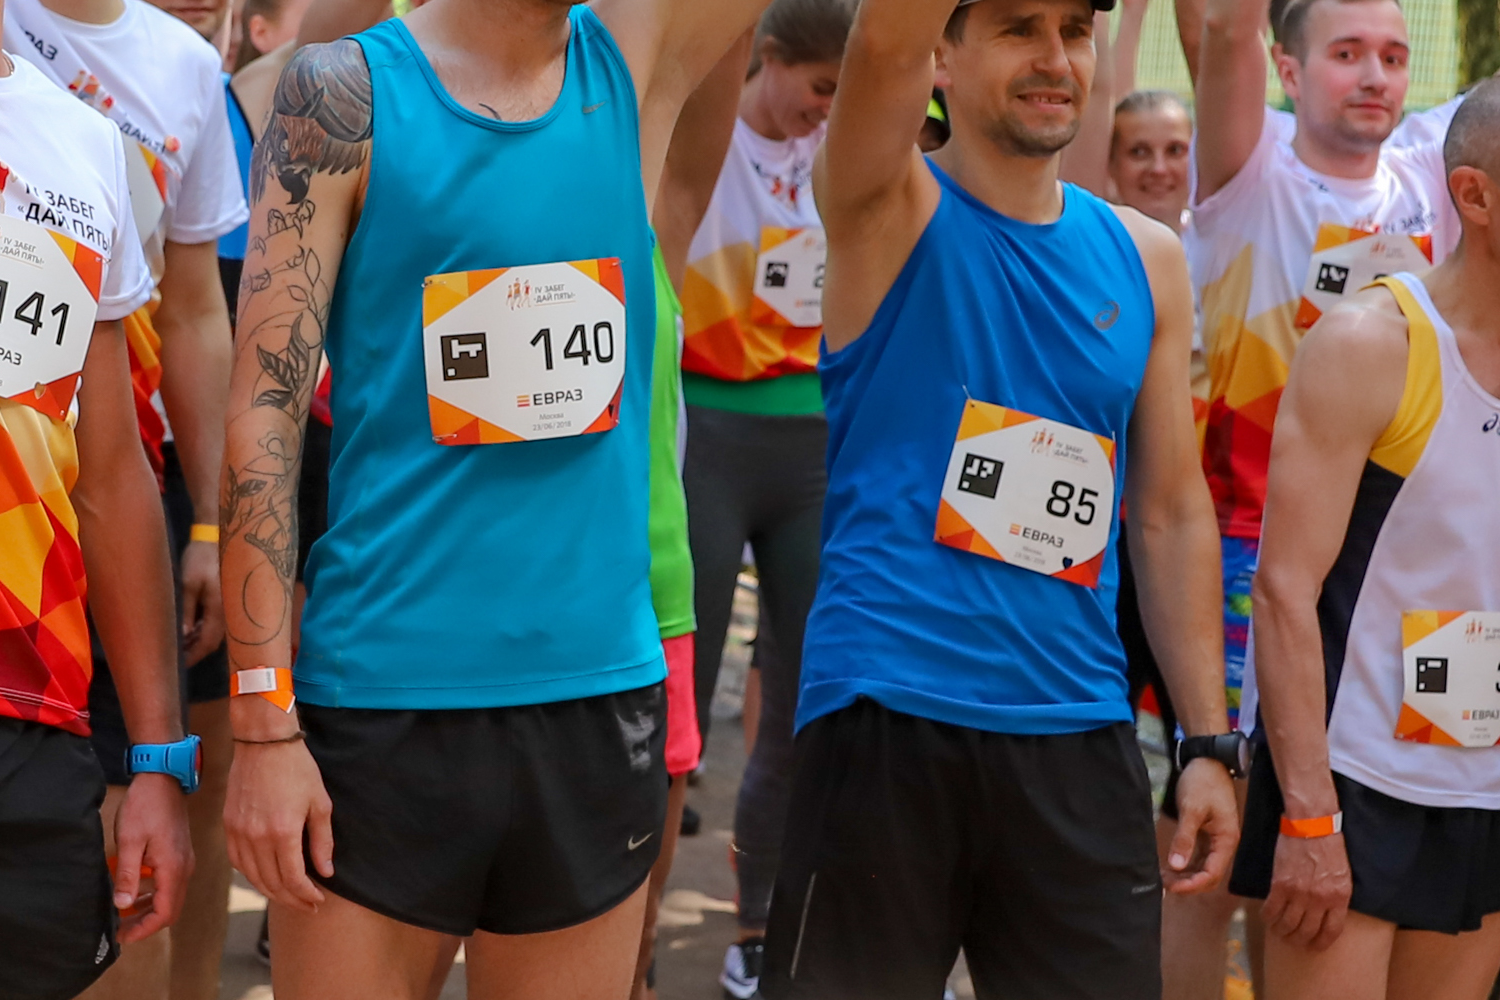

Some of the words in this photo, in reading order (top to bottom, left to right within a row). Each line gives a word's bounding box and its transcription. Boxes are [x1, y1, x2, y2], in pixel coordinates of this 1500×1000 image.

[44, 190, 95, 220] ЗАБЕГ
[3, 237, 12, 245] IV
[14, 240, 37, 252] ЗАБЕГ
[534, 286, 543, 294] IV
[544, 283, 566, 293] ЗАБЕГ
[529, 321, 614, 371] 140
[532, 388, 583, 406] ЕВРАЗ
[538, 412, 564, 421] Москва
[1046, 480, 1099, 526] 85
[1022, 527, 1065, 548] ЕВРАЗ
